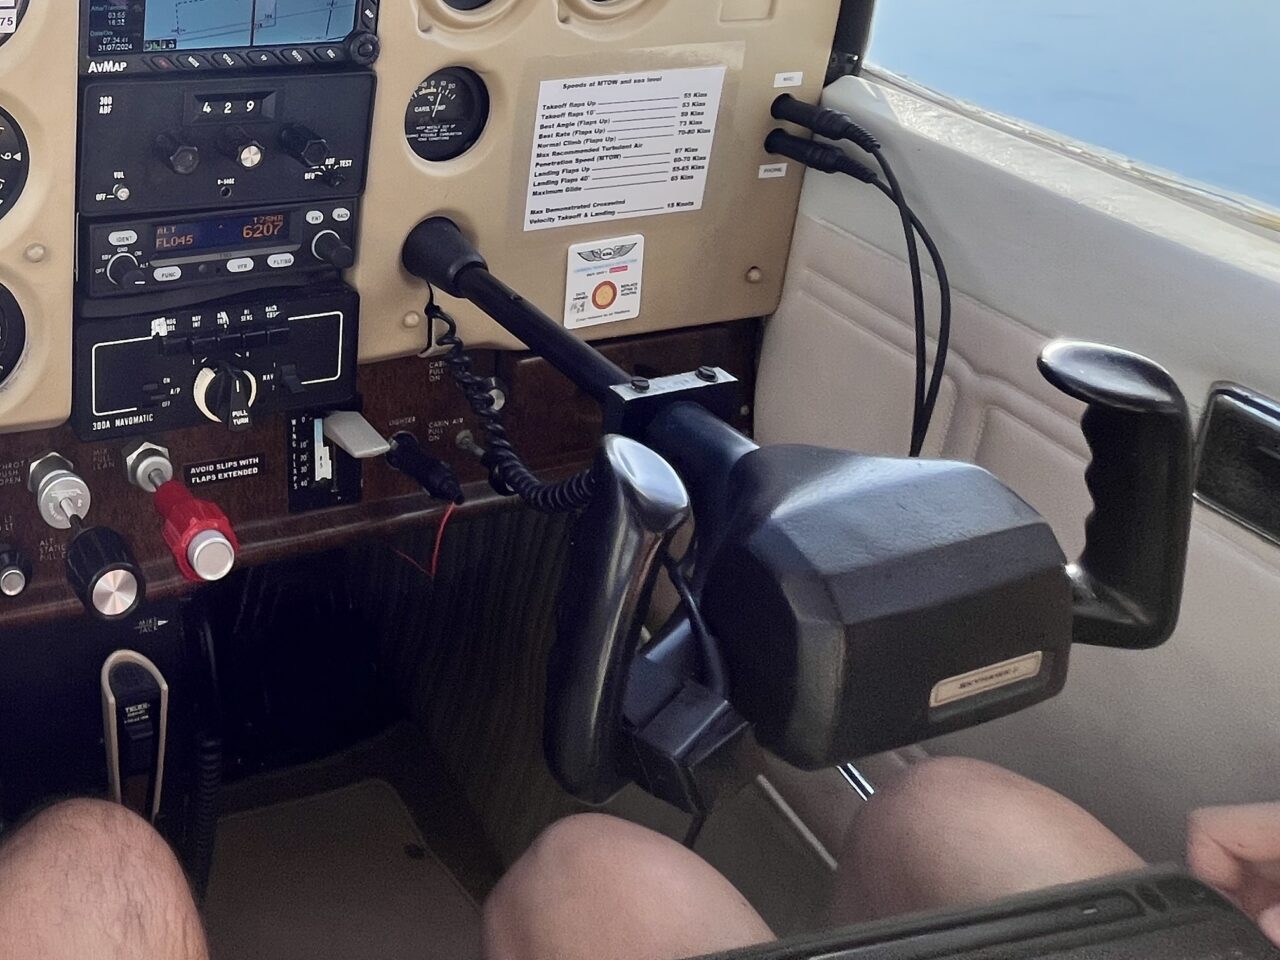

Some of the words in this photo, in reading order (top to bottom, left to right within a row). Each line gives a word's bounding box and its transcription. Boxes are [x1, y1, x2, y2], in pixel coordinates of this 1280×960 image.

[99, 96, 112, 105] 300
[99, 105, 112, 114] ADF
[551, 147, 599, 156] Recommended
[602, 142, 632, 151] Turbulent
[339, 159, 352, 167] TEST
[535, 160, 573, 168] Penetration
[575, 156, 595, 164] Speed
[596, 153, 621, 162] (MTOW)
[534, 170, 560, 178] Landing
[545, 203, 591, 213] Demonstrated
[592, 199, 626, 208] Crosswind
[157, 225, 177, 234] ALT
[243, 222, 284, 238] 6207
[156, 235, 194, 249] FL045
[232, 410, 248, 418] PULL
[92, 420, 111, 431] 300A
[115, 413, 154, 427] NAVOMATIC
[232, 417, 248, 425] TURN
[389, 416, 417, 426] LIGHTER
[428, 420, 449, 429] CABIN
[190, 464, 215, 474] AVOID
[216, 461, 238, 471] SLIPS
[239, 457, 260, 467] WITH
[191, 473, 217, 483] FLAPS
[218, 467, 259, 480] EXTENDED
[40, 537, 54, 546] ALT
[40, 544, 67, 553] STATIC
